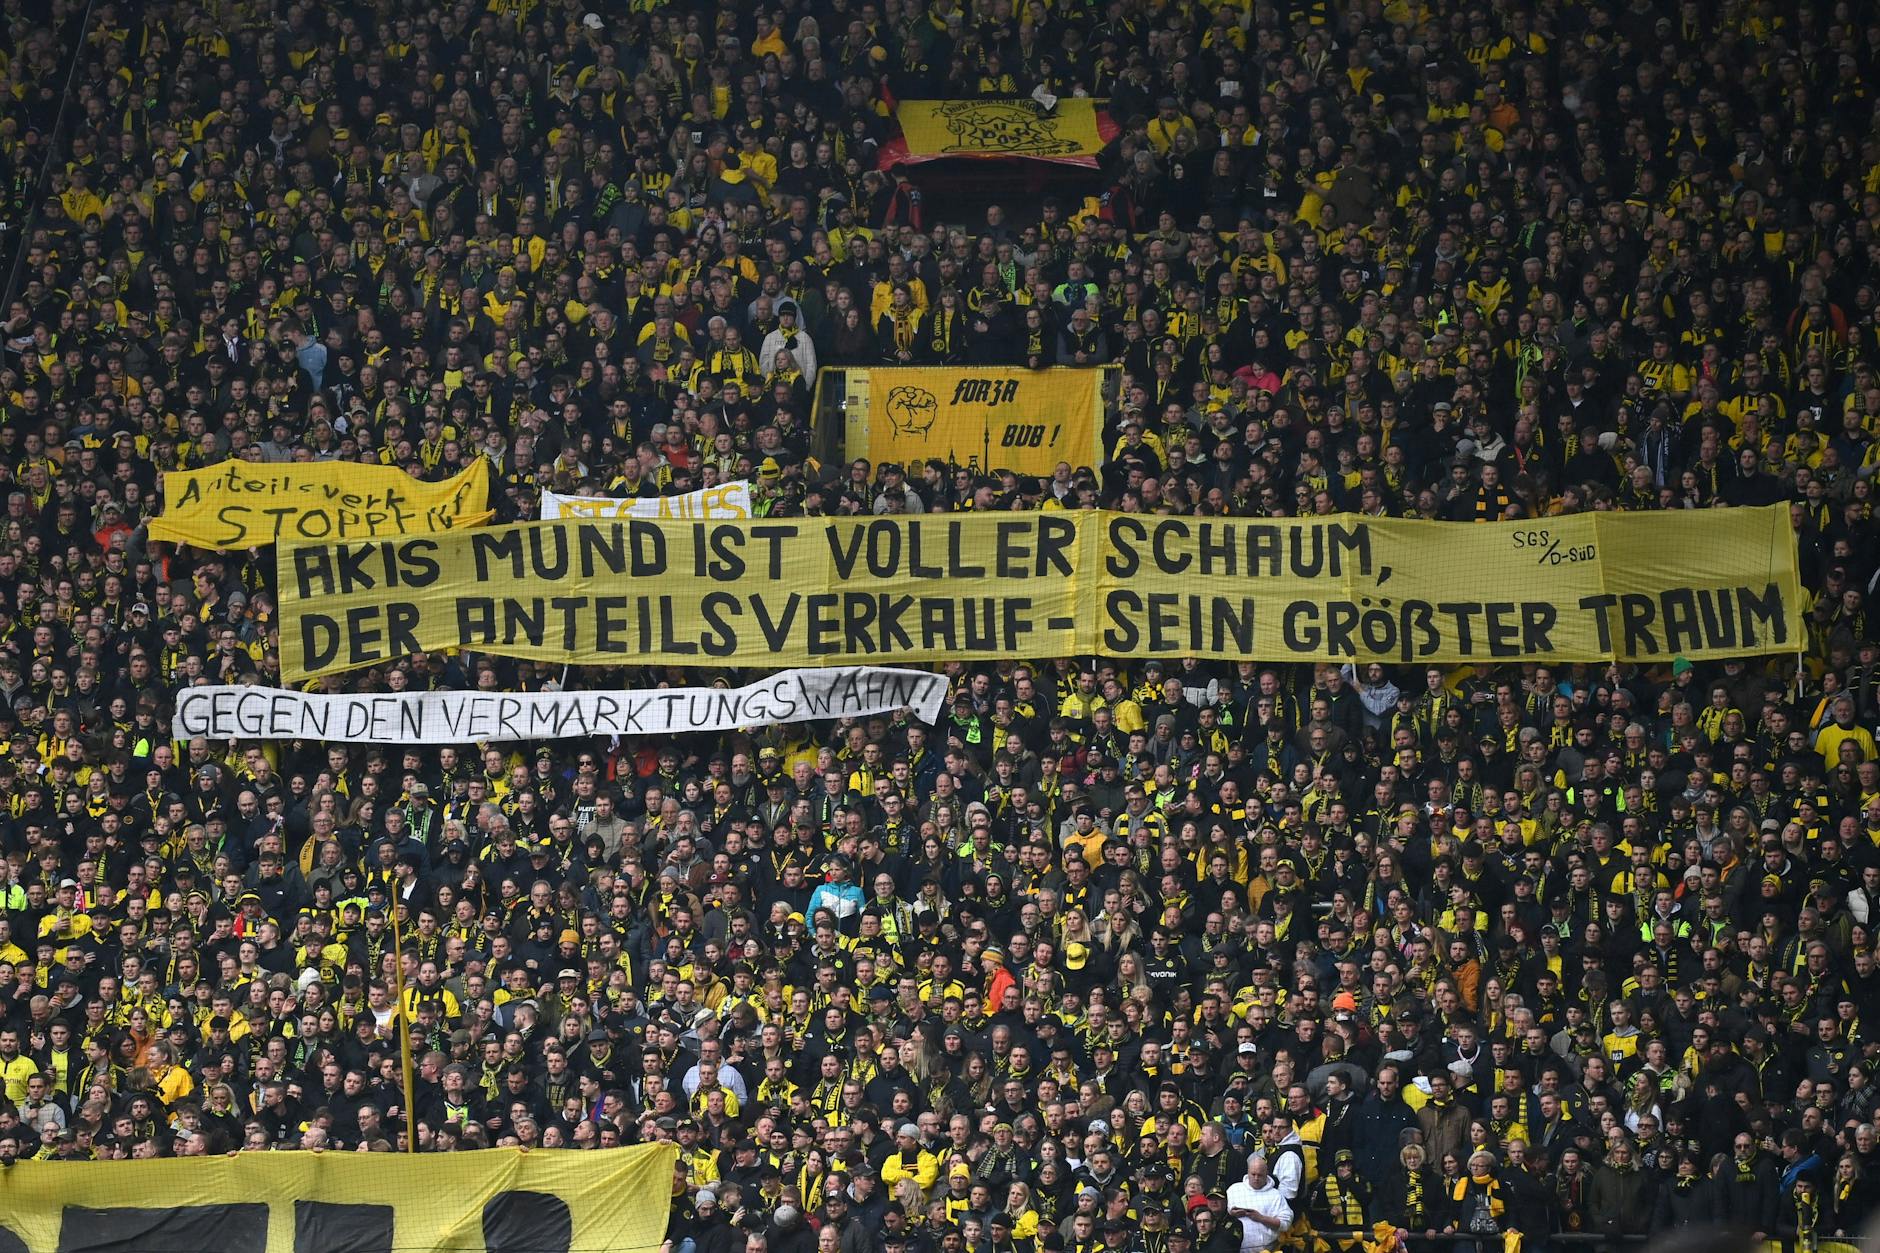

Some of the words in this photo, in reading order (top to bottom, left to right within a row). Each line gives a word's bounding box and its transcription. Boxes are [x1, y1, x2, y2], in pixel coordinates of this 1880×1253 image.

[1019, 99, 1037, 111] IRA
[293, 539, 440, 599] AKIS
[472, 520, 667, 583] MUND
[694, 522, 798, 582] IST
[825, 514, 1076, 580] VOLLER
[1106, 516, 1392, 587] SCHAUM,
[301, 602, 423, 672] DER
[1104, 589, 1254, 654] SEIN
[1579, 582, 1788, 657] TRAUM
[179, 693, 330, 737] GEGEN
[345, 698, 424, 740] DEN
